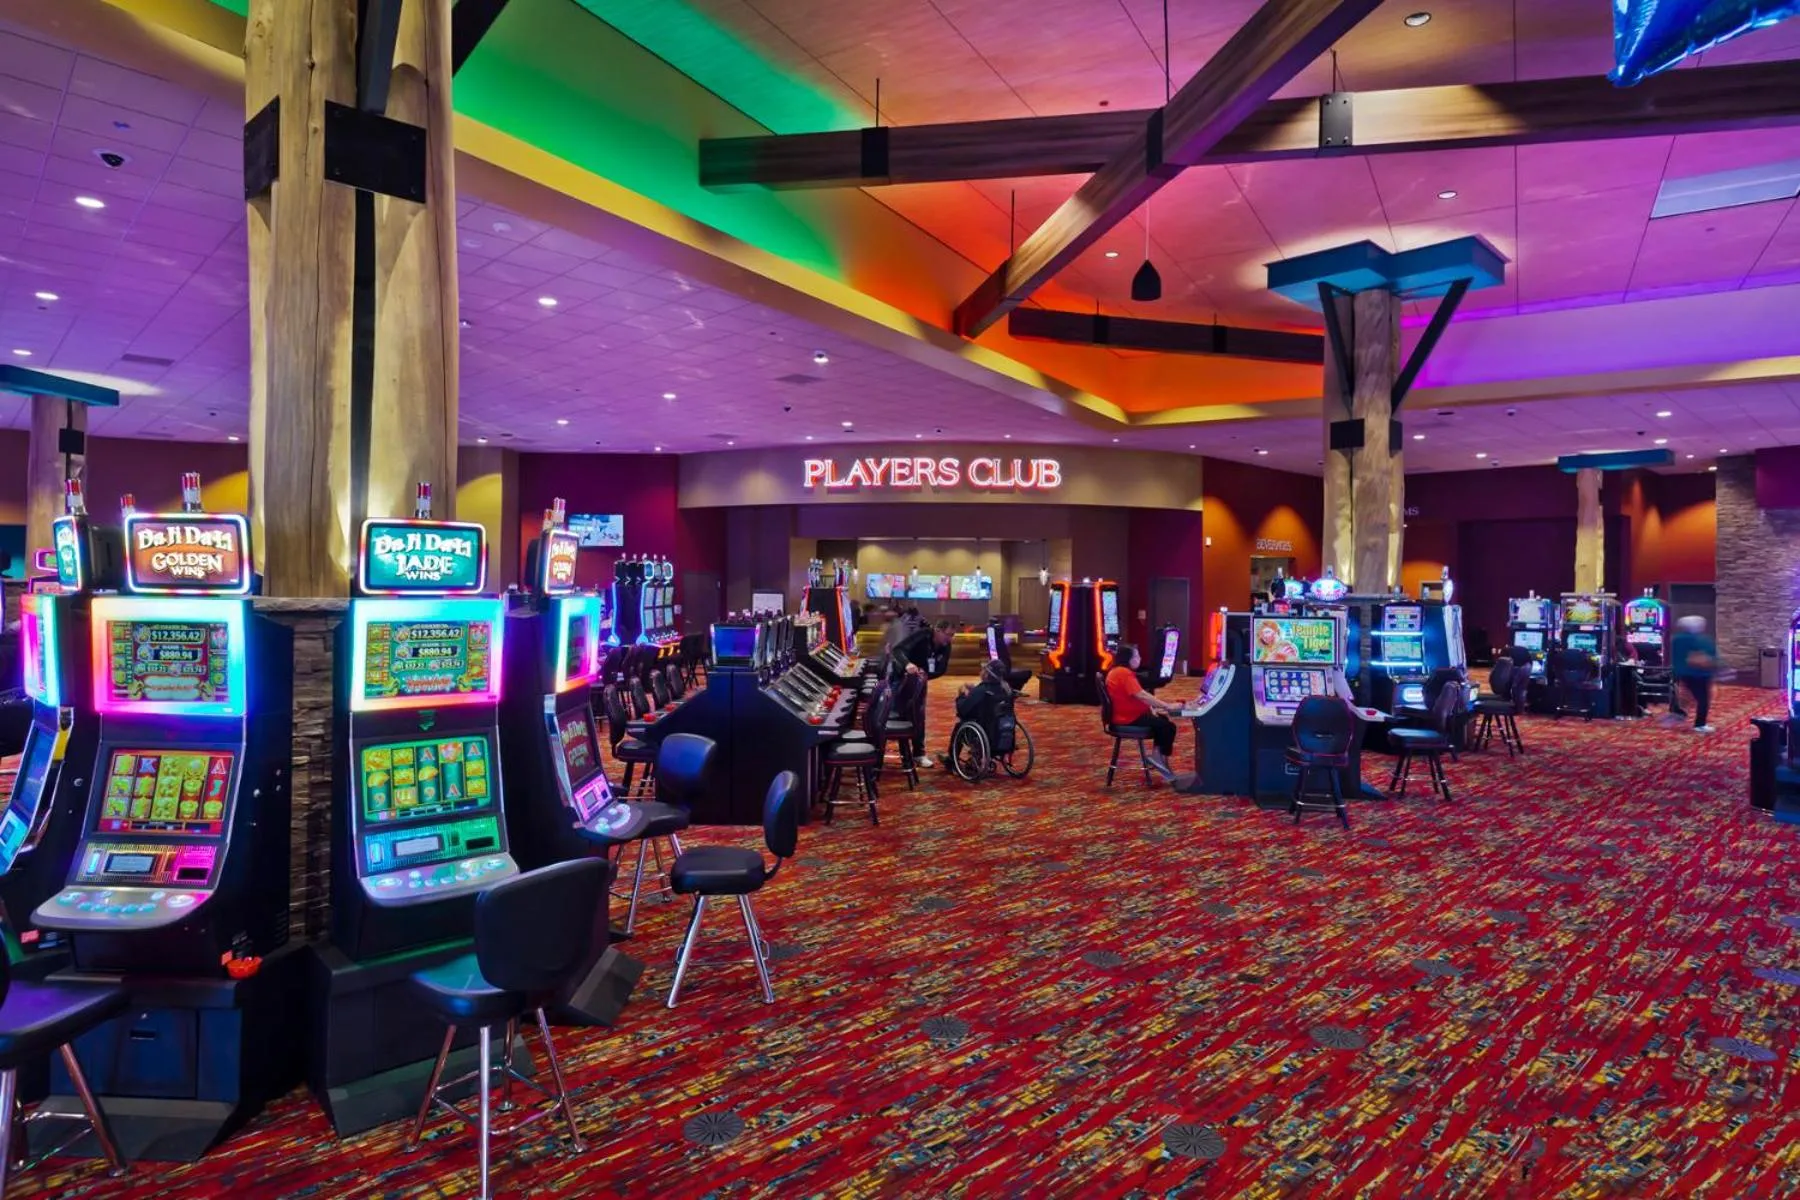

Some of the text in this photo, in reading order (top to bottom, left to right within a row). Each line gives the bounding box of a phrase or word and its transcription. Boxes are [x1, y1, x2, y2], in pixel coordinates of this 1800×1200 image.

[803, 458, 1062, 488] PLAYERS CLUB
[152, 552, 224, 573] GOLDEN
[395, 553, 453, 576] JADE
[170, 566, 206, 578] WINS
[404, 571, 441, 581] WINS
[1292, 623, 1330, 637] Temple
[1303, 637, 1330, 651] Tiger
[140, 758, 227, 775] K A
[444, 784, 462, 799] A
